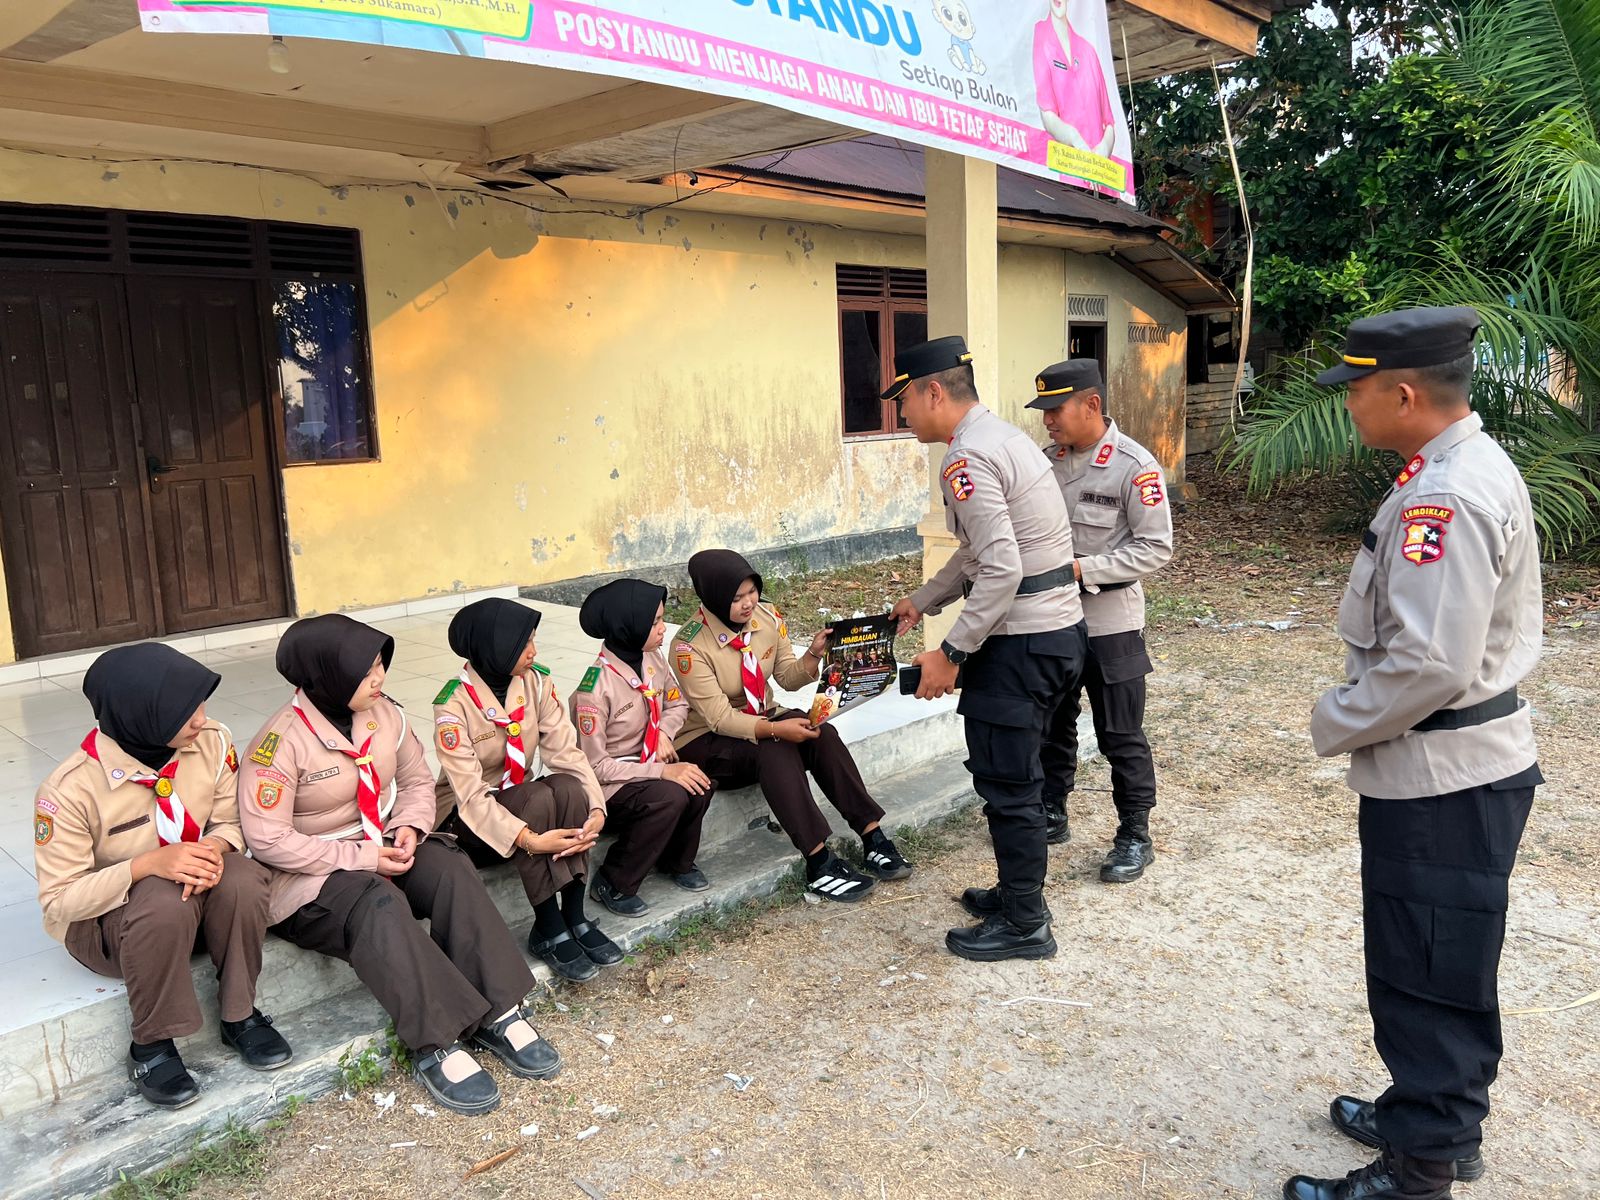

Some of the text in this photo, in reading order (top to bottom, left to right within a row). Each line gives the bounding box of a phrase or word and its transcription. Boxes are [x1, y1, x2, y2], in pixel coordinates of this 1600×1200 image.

[553, 10, 1028, 153] POSYANDU MENJAGA ANAK DAN IBU TETAP SEHAT
[899, 59, 1018, 113] Setiap Bulan
[1404, 508, 1450, 518] LEMDIKLAT
[841, 632, 878, 645] HIMBAUAN
